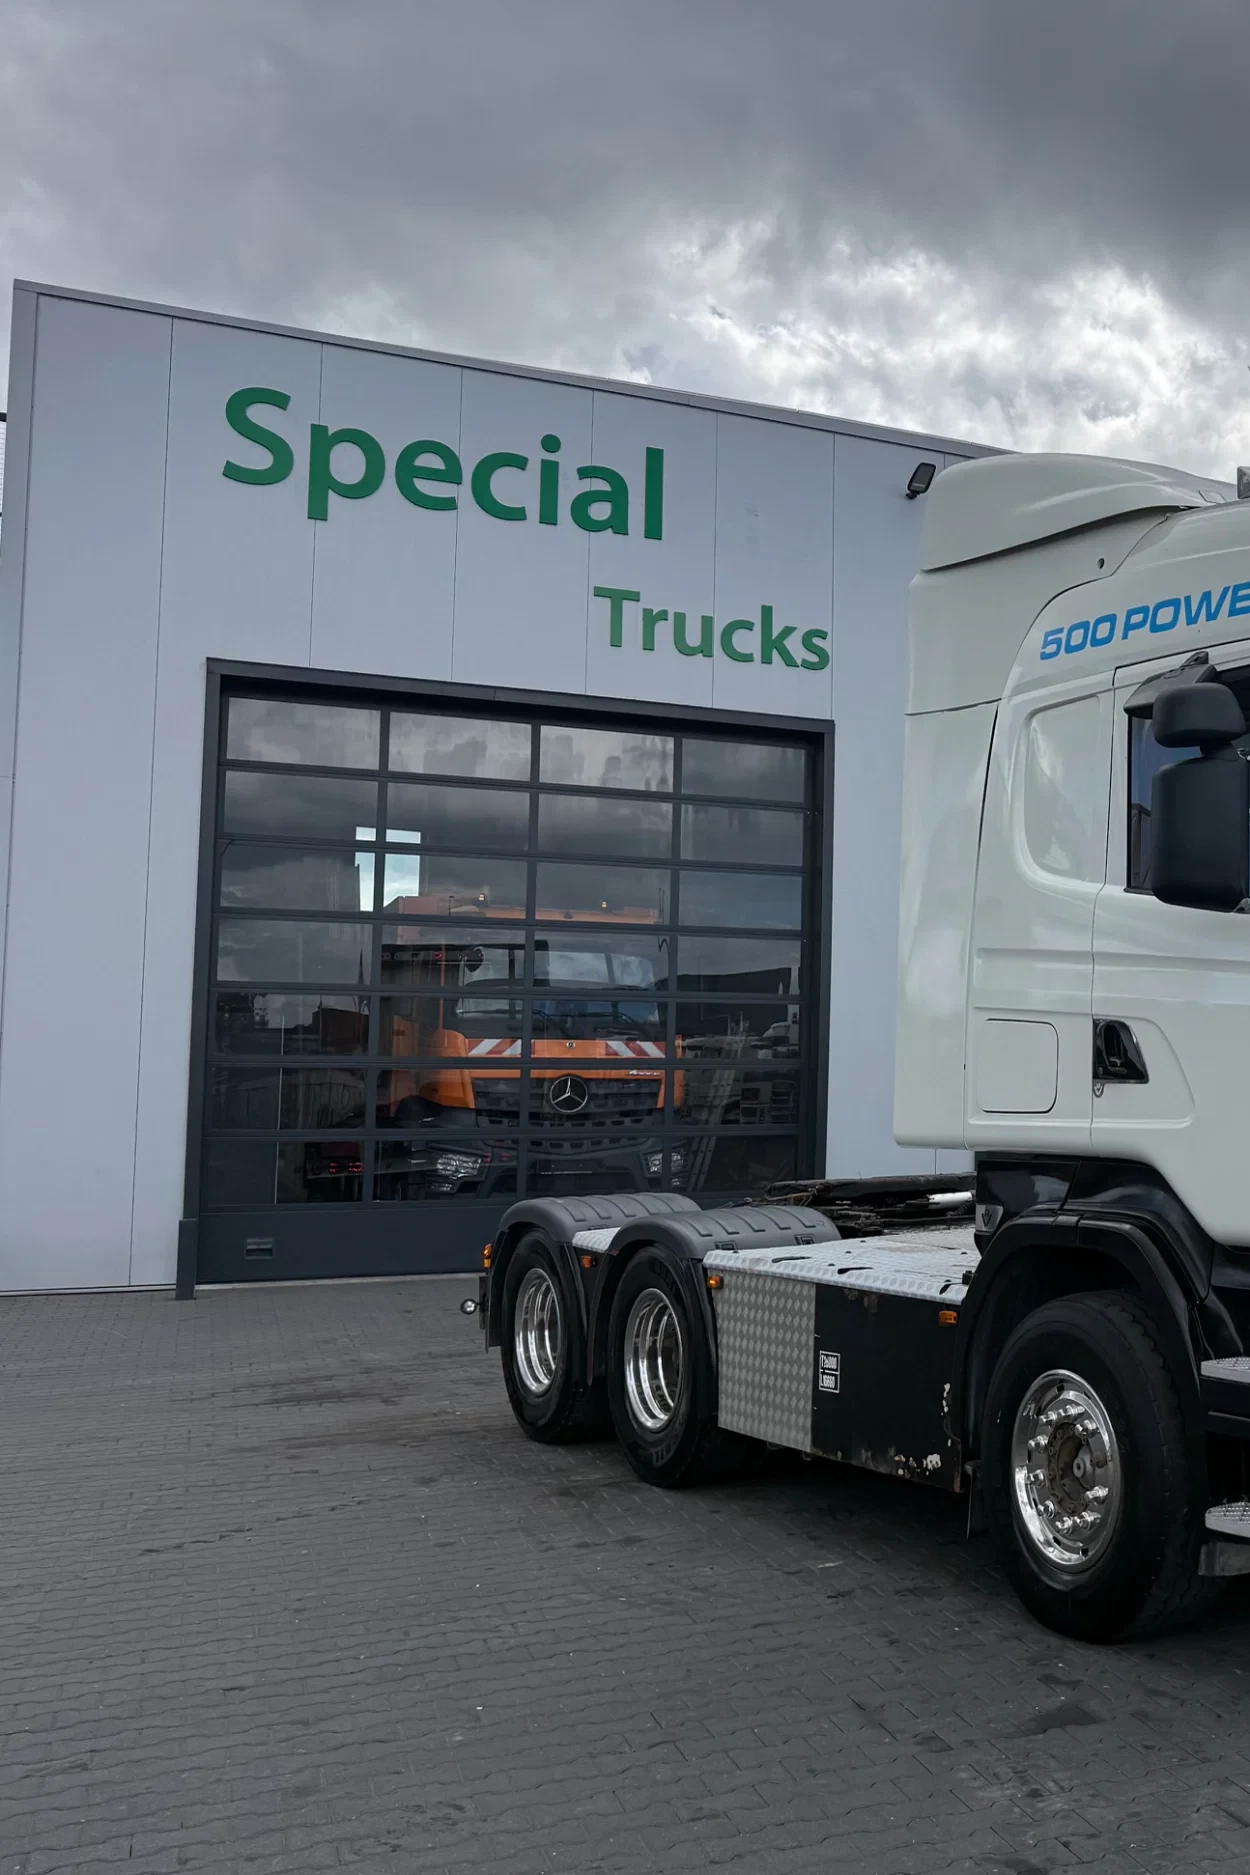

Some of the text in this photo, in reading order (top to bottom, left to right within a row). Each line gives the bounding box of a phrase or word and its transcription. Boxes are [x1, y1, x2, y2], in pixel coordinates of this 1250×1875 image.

[222, 387, 664, 540] Special
[593, 586, 831, 670] Trucks
[1040, 613, 1117, 660] 500
